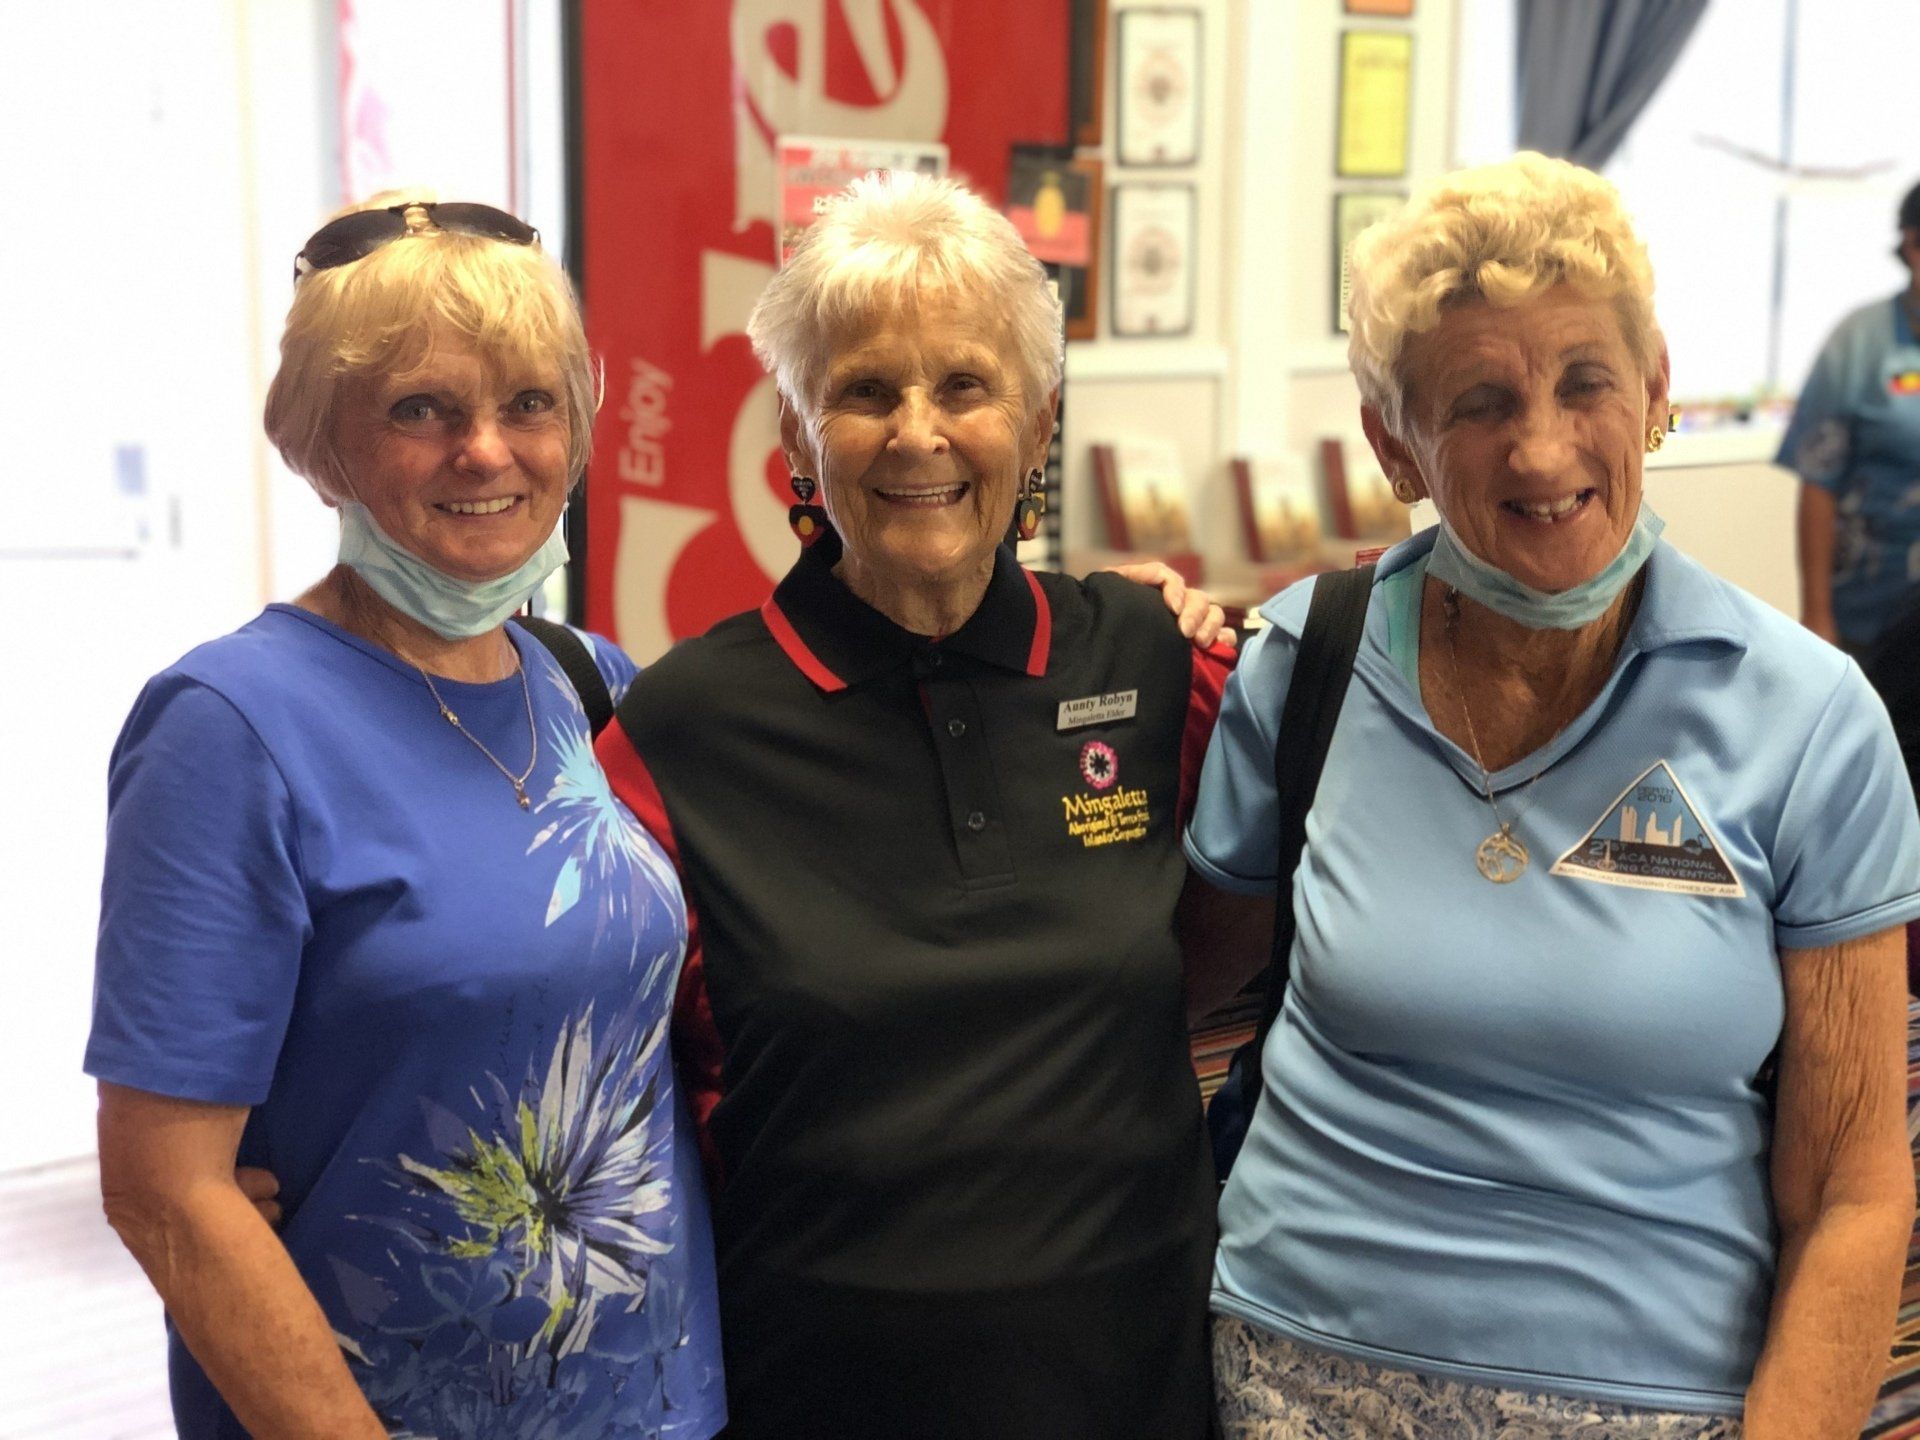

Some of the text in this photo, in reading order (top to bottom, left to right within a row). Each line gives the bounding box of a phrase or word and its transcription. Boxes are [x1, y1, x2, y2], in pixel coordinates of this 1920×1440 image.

[617, 357, 674, 487] Enjoy
[1063, 692, 1133, 713] Aunty Robyn
[1618, 852, 1716, 870] ACA NATIONAL
[1641, 863, 1728, 881] CONVENTION
